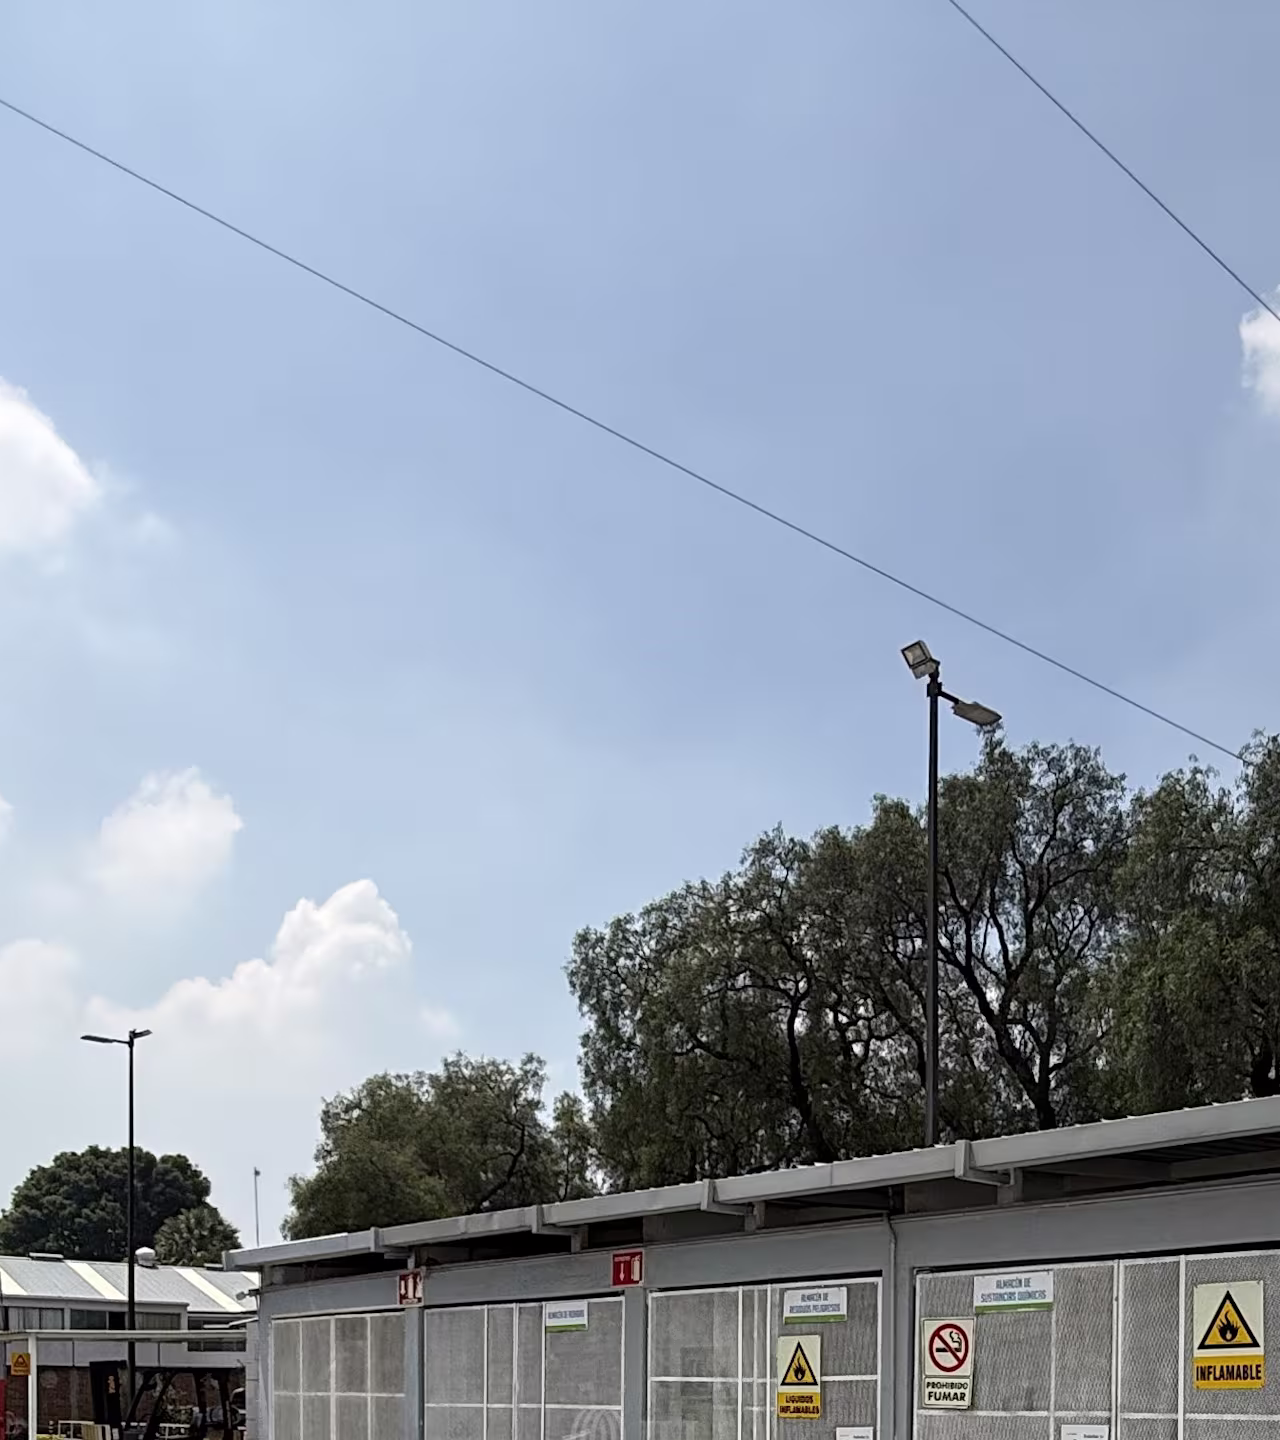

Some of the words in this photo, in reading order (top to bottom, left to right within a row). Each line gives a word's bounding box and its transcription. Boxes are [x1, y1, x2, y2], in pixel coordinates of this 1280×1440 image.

[995, 1277, 1022, 1289] ALMACÉN
[1024, 1277, 1032, 1288] DE
[981, 1292, 1016, 1303] SUSTANCIAS
[1196, 1364, 1262, 1381] INFLAMABLE
[926, 1381, 968, 1390] PROHIBIDO
[928, 1391, 966, 1401] FUMAR
[779, 1405, 820, 1414] INFLAMABLES
